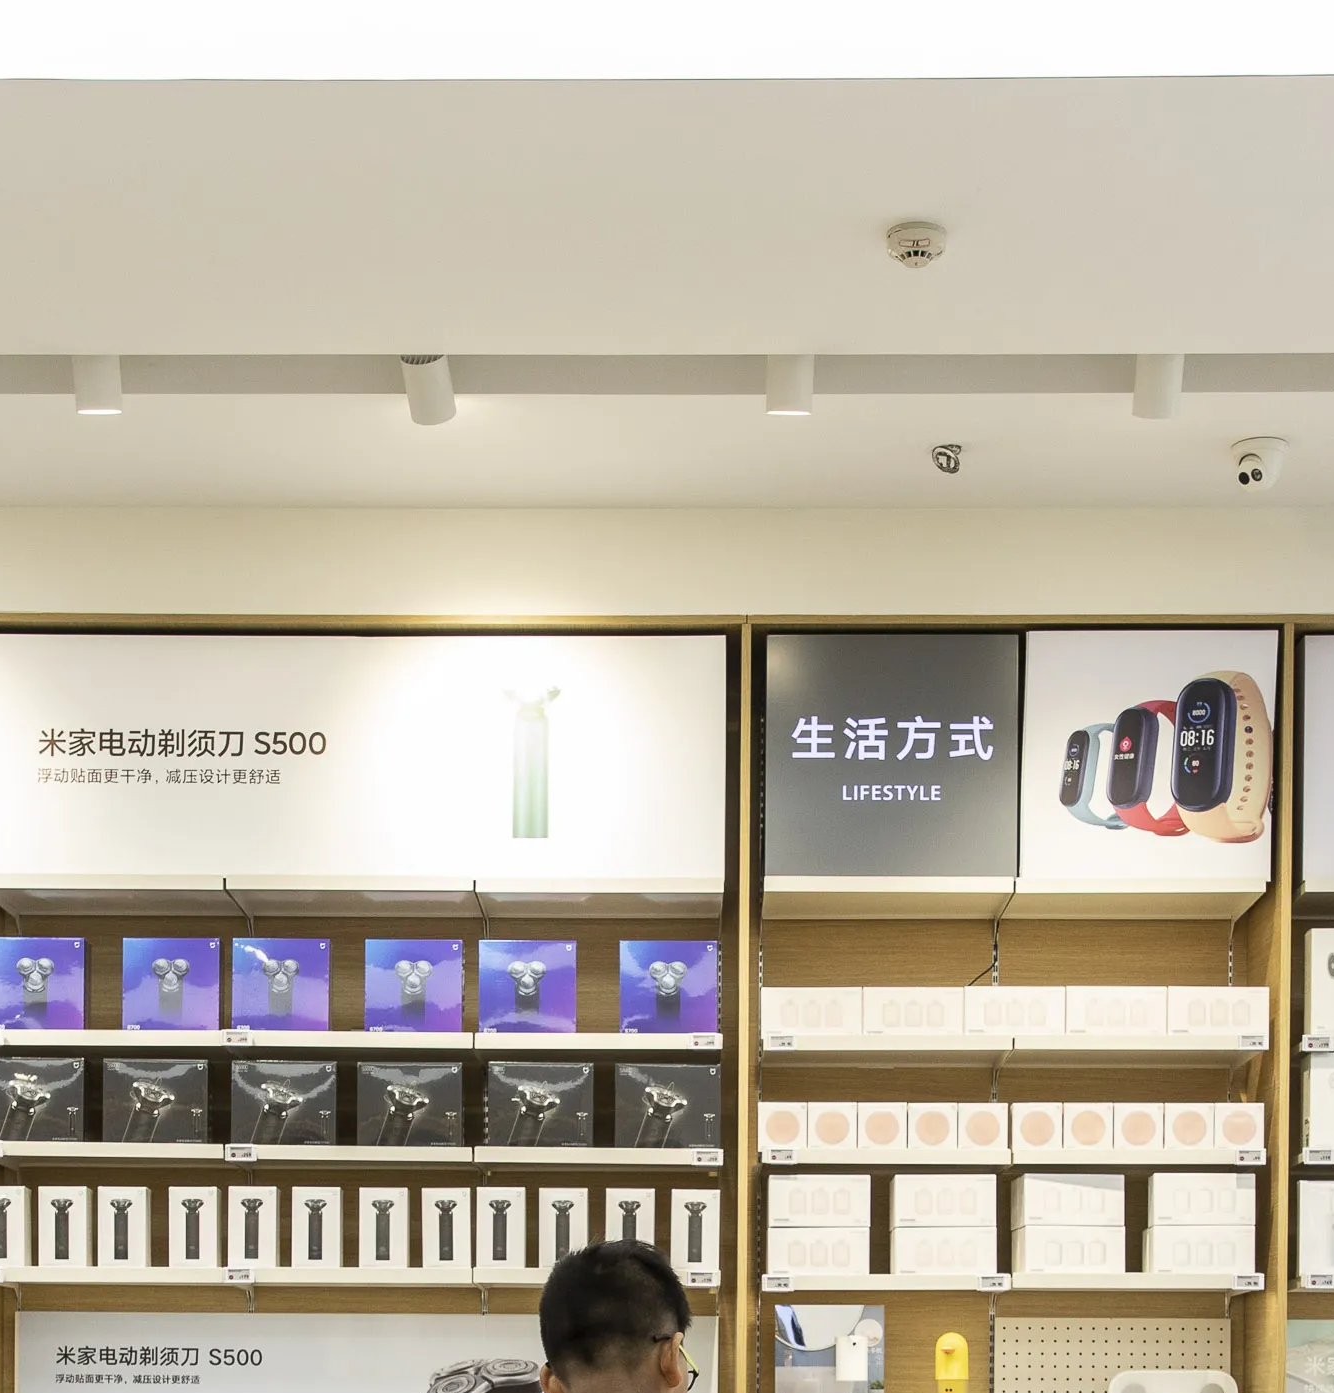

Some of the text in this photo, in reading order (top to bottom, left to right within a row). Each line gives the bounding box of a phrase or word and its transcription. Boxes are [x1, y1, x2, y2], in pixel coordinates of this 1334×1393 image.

[39, 728, 327, 757] 米家电动剃须刀 S500
[791, 715, 994, 761] 生活方式
[1180, 730, 1215, 747] 08:16
[842, 784, 942, 801] LIFESTYLE
[55, 1345, 263, 1367] 米家电动剃须刀 S500
